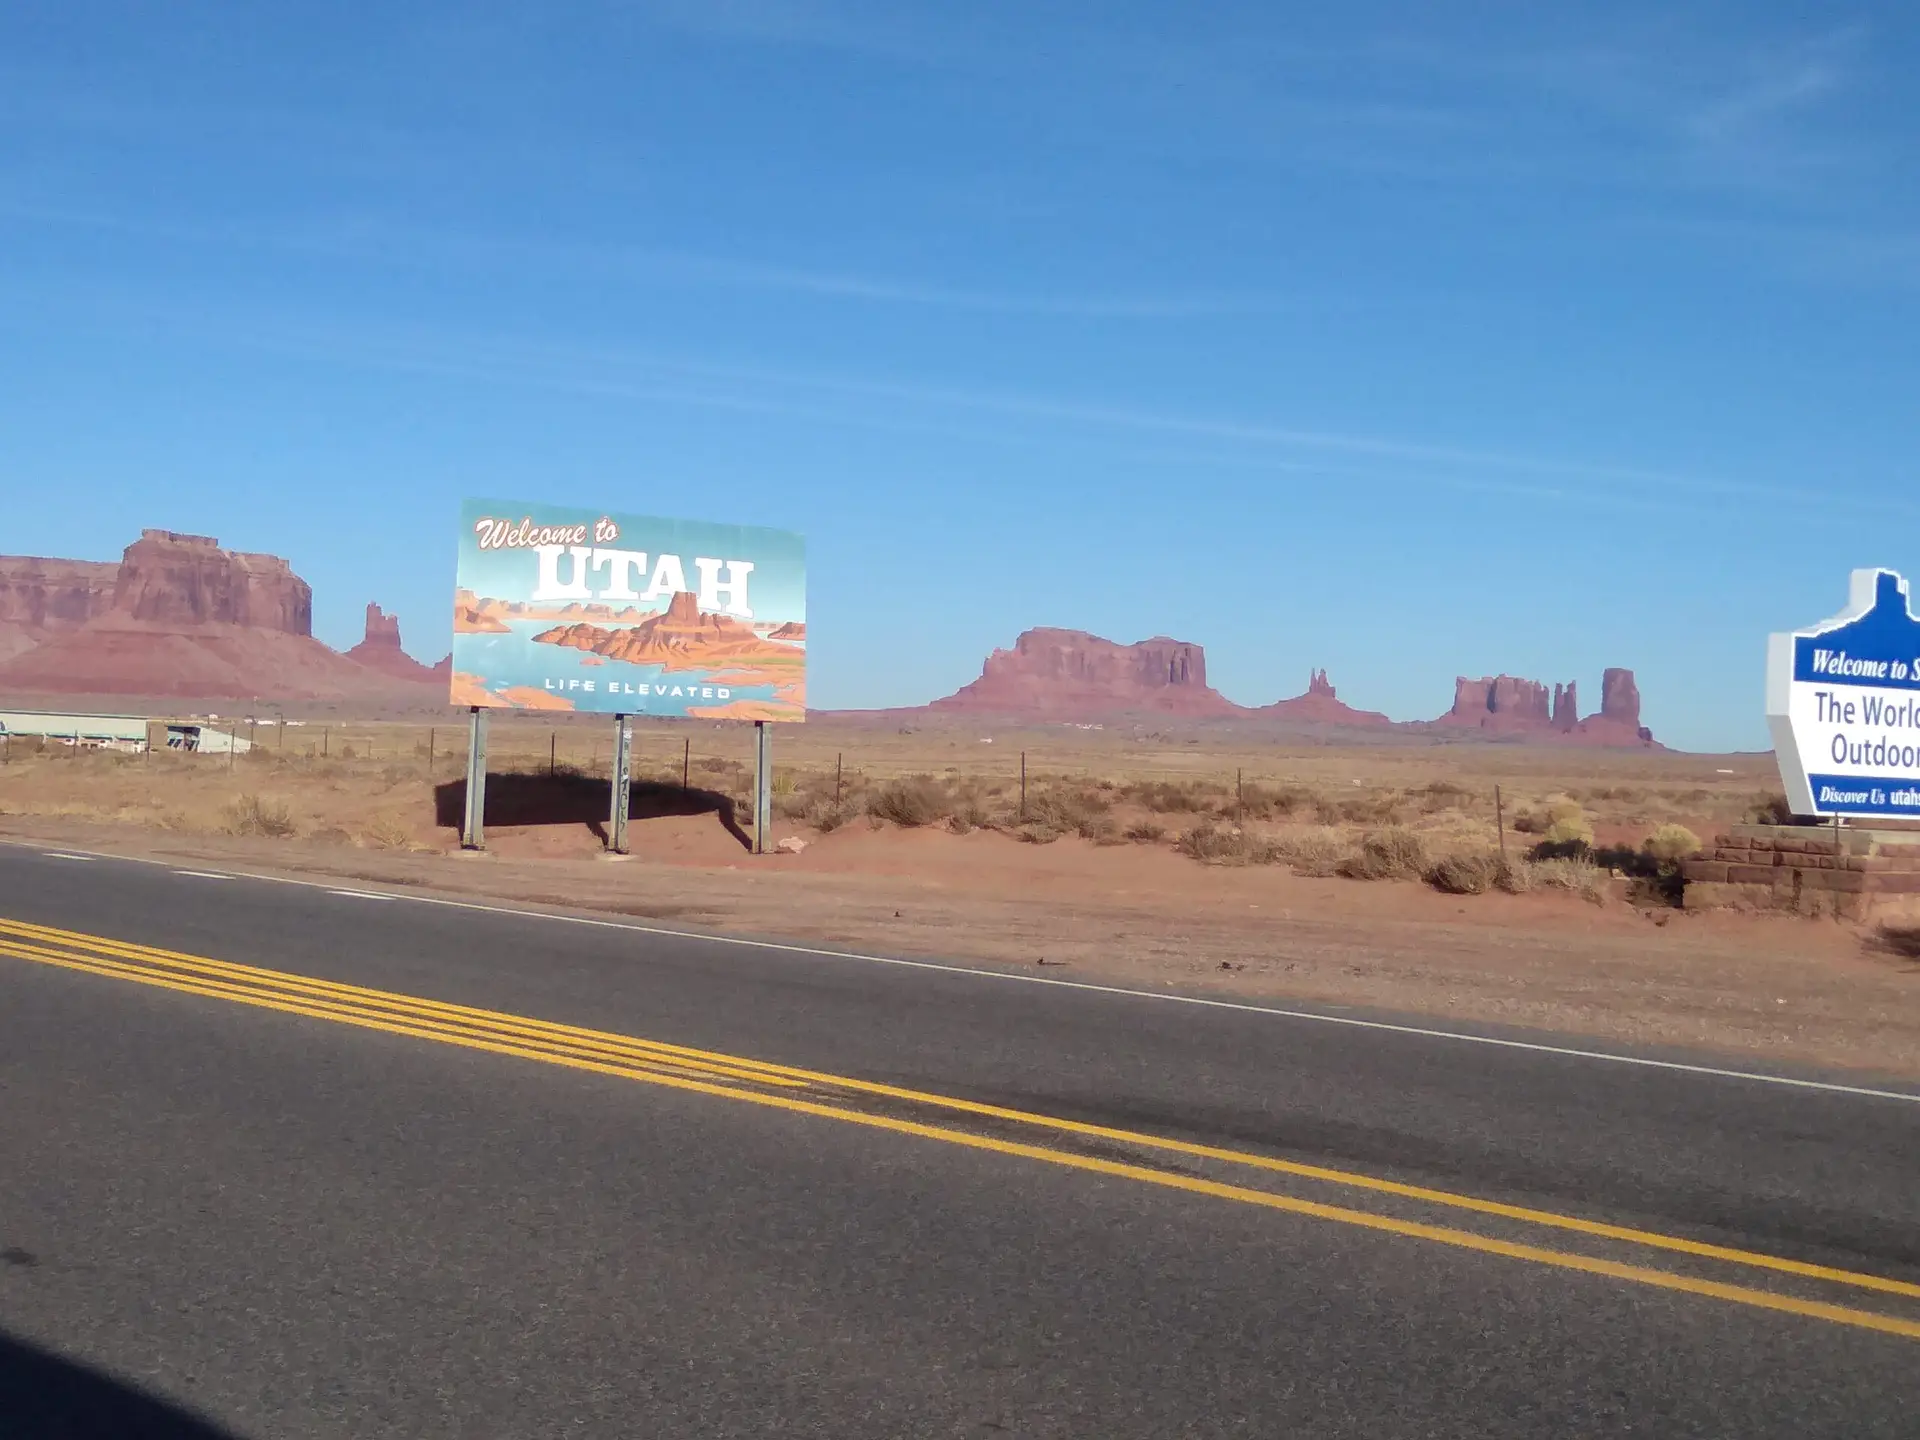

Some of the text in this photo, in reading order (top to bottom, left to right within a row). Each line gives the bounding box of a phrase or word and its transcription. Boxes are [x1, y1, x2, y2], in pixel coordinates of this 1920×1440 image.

[475, 517, 618, 550] Welcome to
[532, 545, 755, 619] UTAH
[1812, 648, 1888, 680] Welcome
[1890, 658, 1907, 681] to
[545, 678, 730, 699] LIFE ELEVATED
[1814, 691, 1856, 724] The
[1819, 785, 1869, 804] Discover
[1870, 788, 1885, 805] Us
